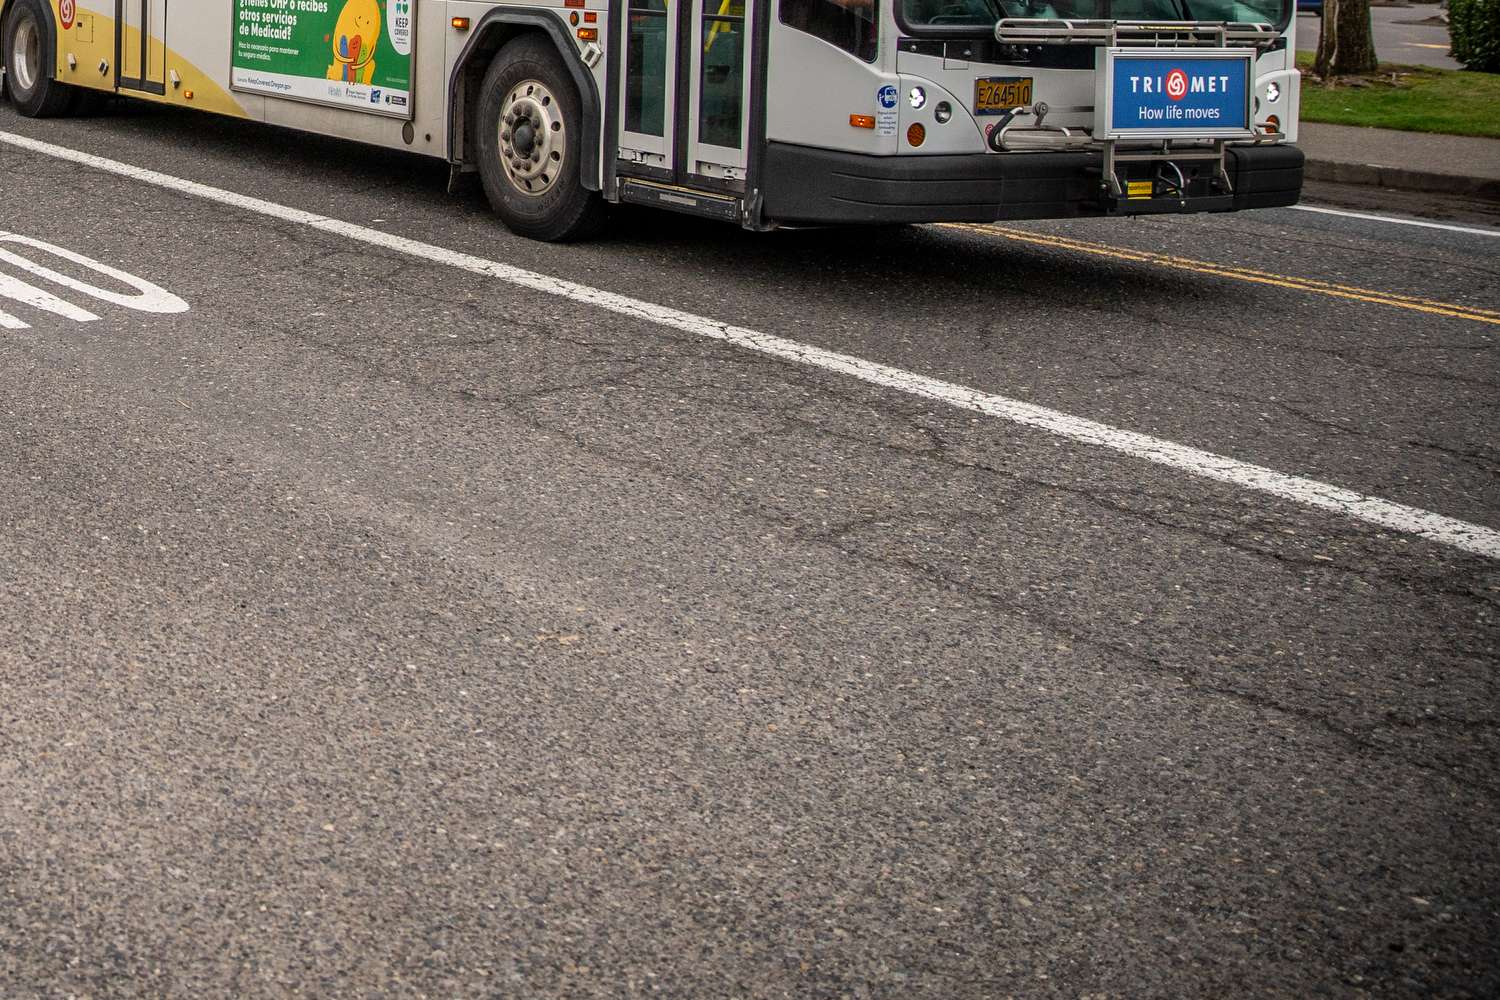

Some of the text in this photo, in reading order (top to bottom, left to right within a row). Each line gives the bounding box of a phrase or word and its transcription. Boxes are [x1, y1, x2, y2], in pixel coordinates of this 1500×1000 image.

[289, 0, 296, 10] o
[239, 9, 297, 26] otros servicios
[395, 17, 409, 28] KEEP
[239, 22, 292, 40] de Medicaid?
[978, 85, 1030, 105] E264510
[1138, 104, 1220, 120] How life moves
